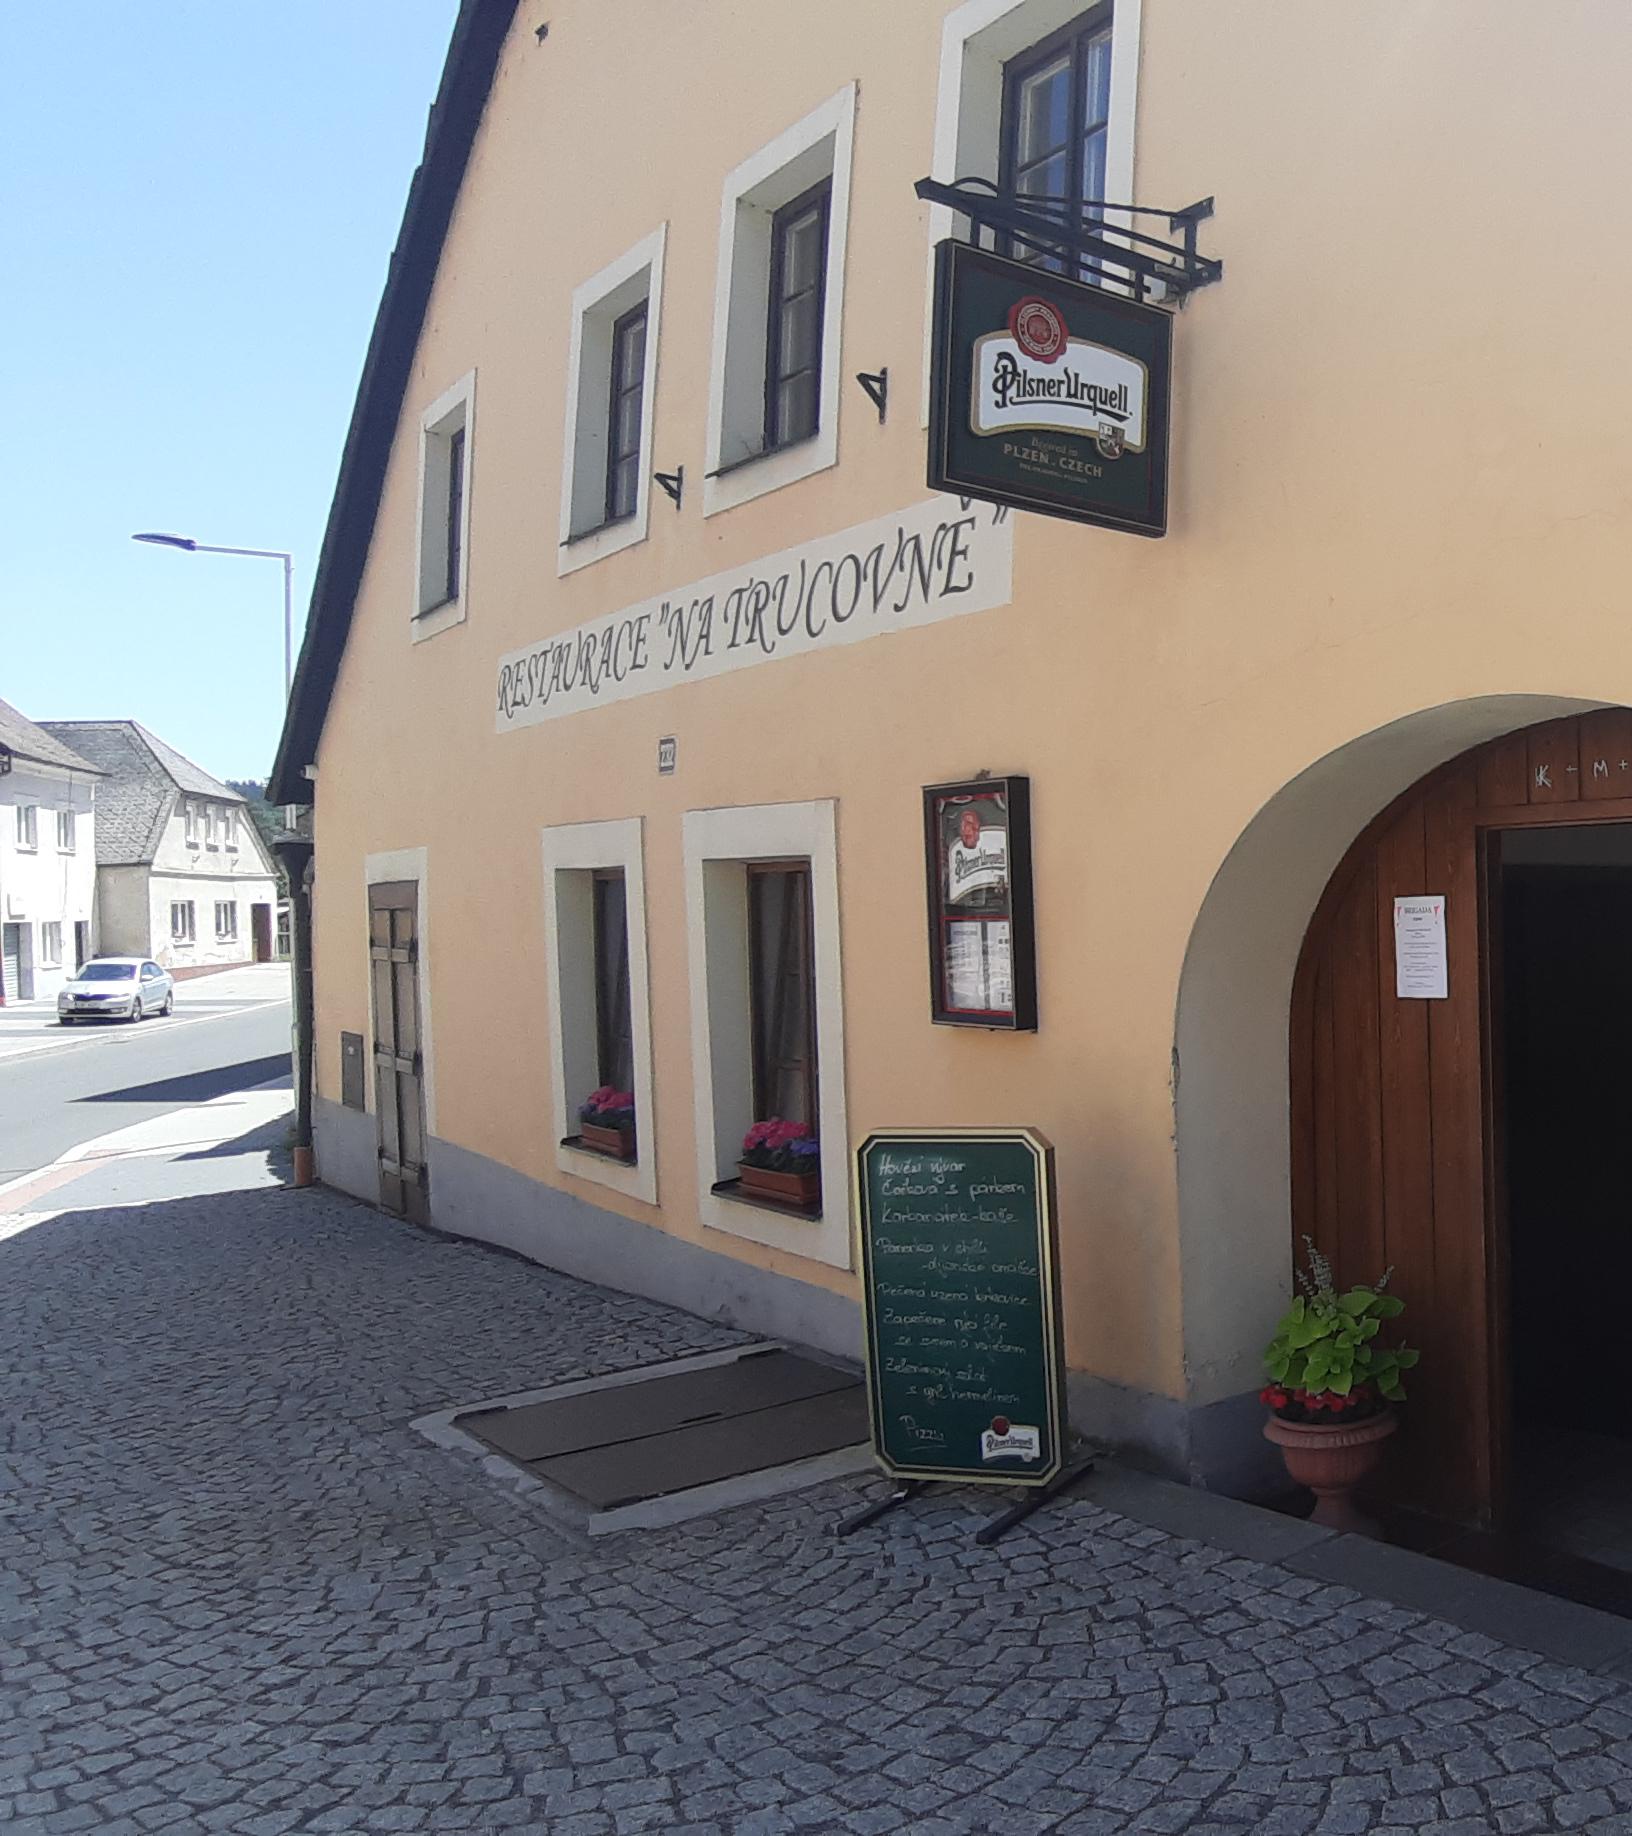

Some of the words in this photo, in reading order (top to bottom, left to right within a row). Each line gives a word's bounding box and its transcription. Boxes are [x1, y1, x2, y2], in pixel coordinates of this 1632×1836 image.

[992, 351, 1065, 409] Pilsner
[1059, 457, 1104, 478] CZECH
[497, 613, 652, 719] RESTAURACE
[1535, 765, 1552, 788] K
[1593, 760, 1609, 778] M
